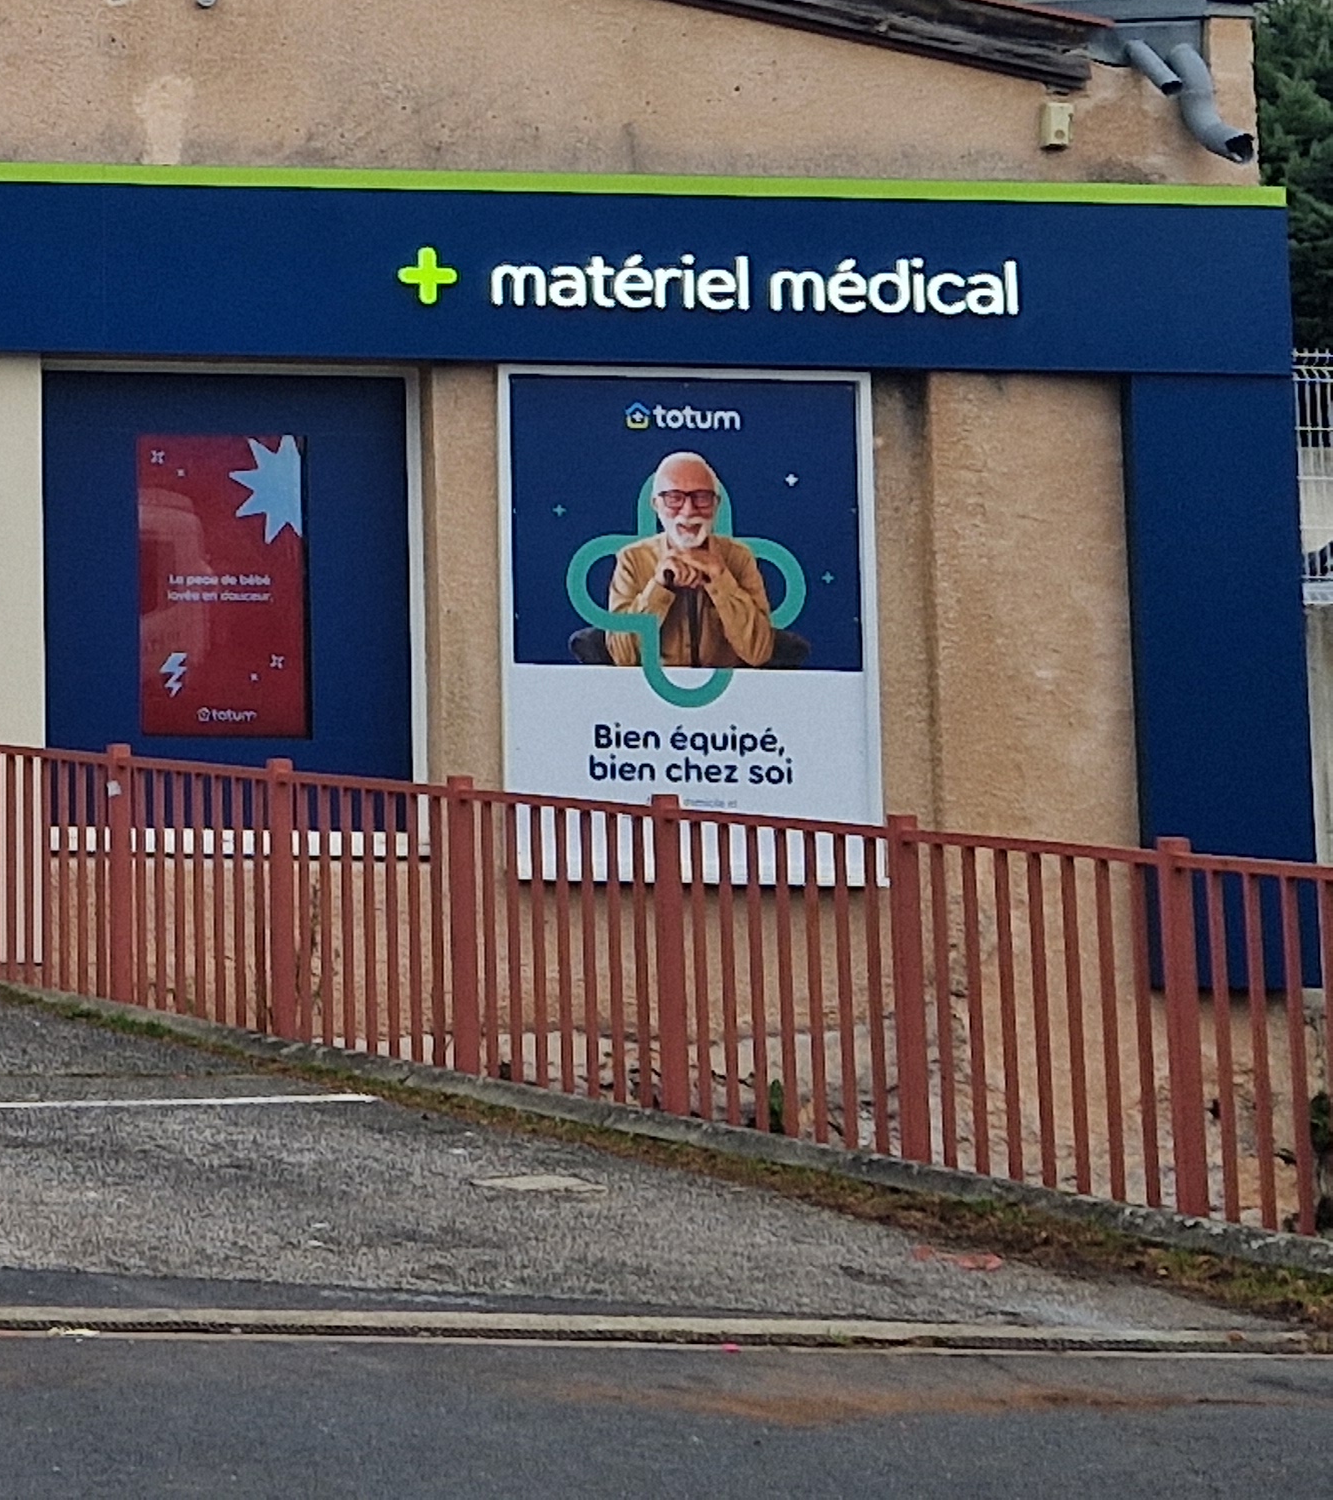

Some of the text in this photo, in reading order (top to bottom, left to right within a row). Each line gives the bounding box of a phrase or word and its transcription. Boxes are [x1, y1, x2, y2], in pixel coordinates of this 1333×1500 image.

[491, 253, 1020, 315] matériel médical
[653, 404, 741, 431] totum
[211, 708, 257, 722] totum
[593, 722, 786, 757] Bien équipé,
[589, 753, 793, 785] bien chez soi
